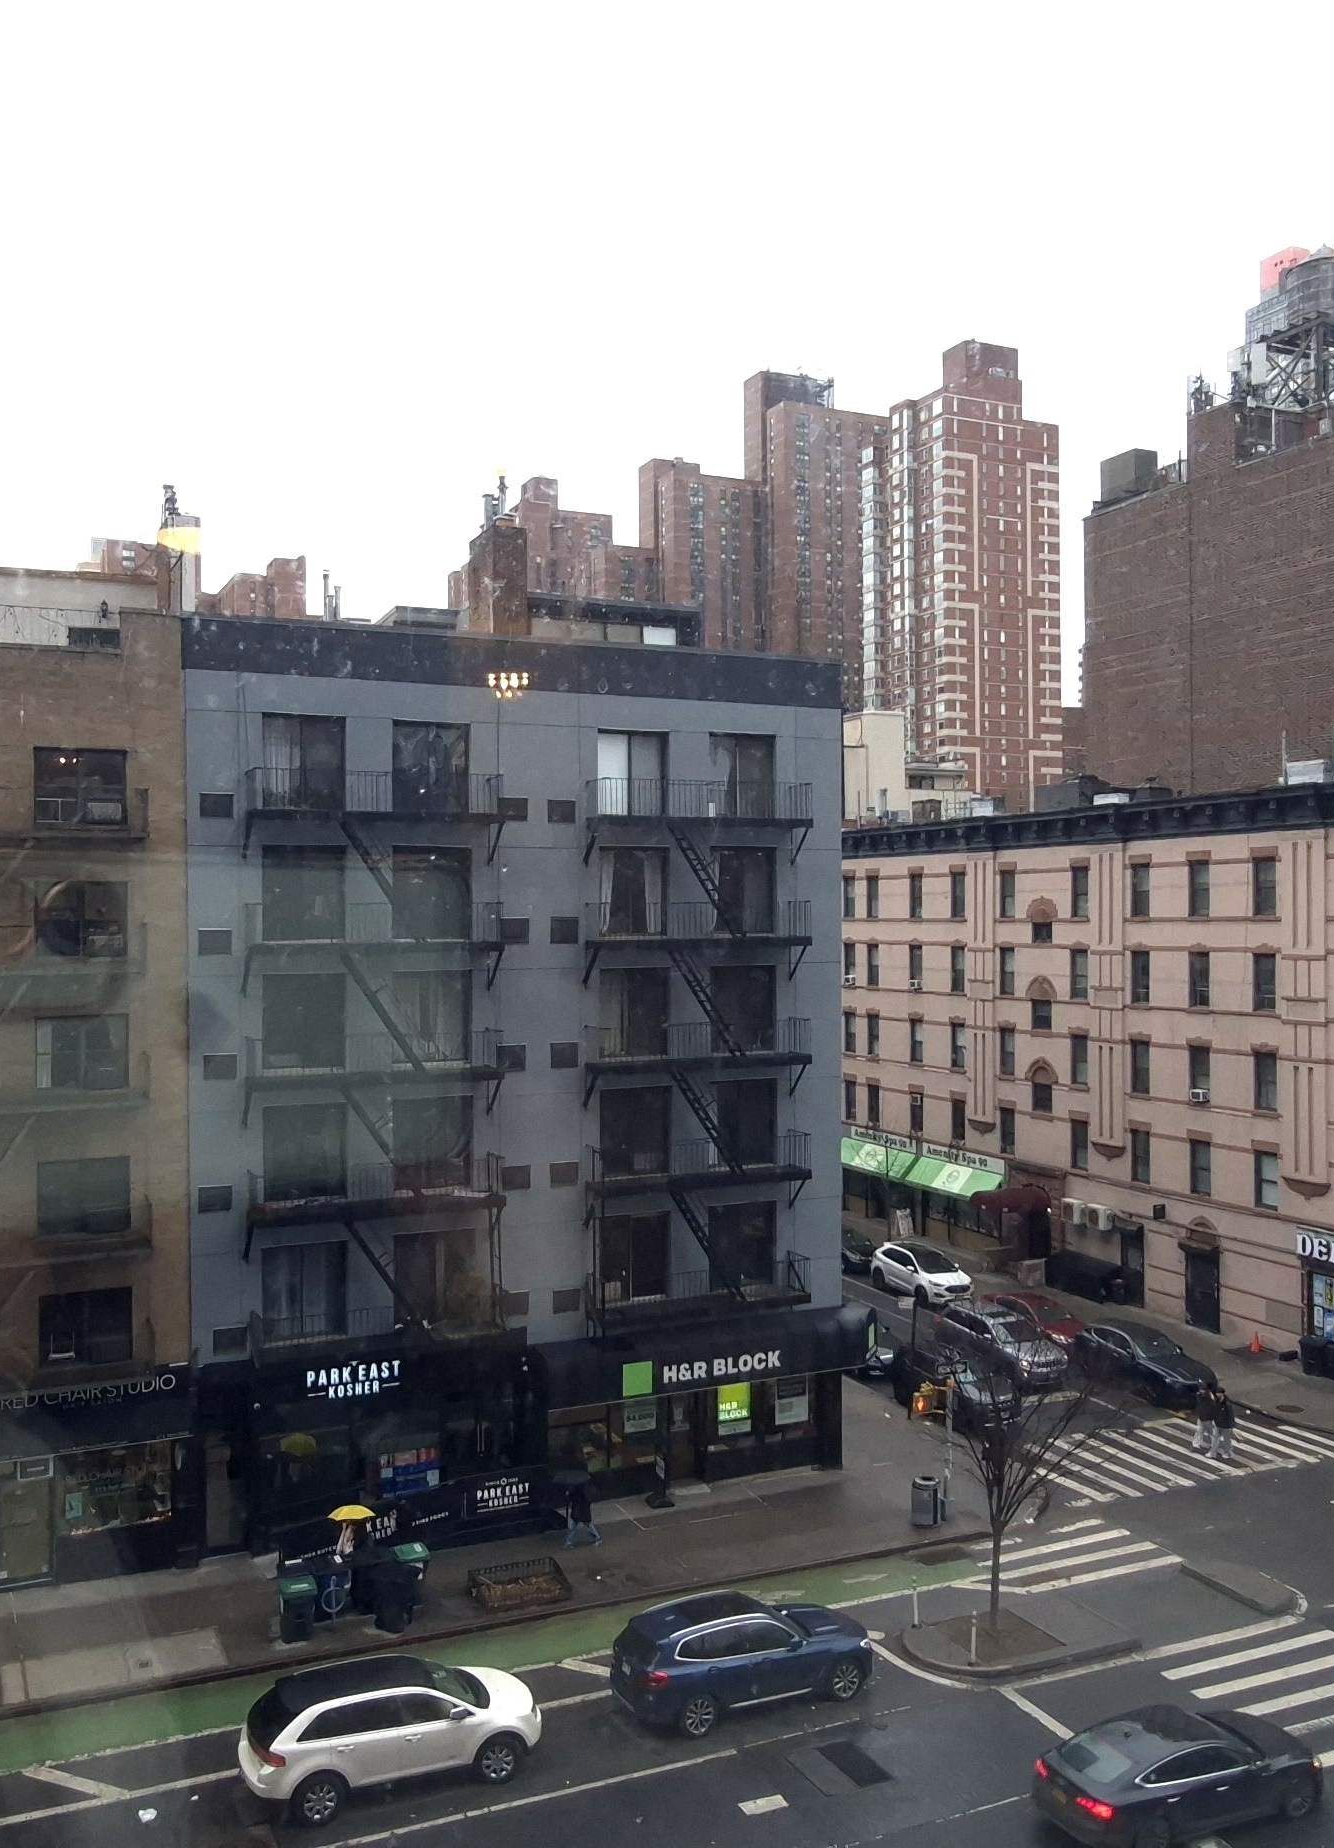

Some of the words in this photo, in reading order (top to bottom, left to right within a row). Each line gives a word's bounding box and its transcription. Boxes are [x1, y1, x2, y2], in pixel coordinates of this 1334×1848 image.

[925, 1144, 960, 1162] Amenity
[961, 1152, 978, 1167] Spa
[307, 1365, 352, 1388] PARK
[358, 1360, 401, 1381] EAST
[663, 1361, 708, 1384] H&R
[713, 1350, 782, 1377] BLOCK
[43, 1385, 102, 1406] CHAIR
[105, 1374, 176, 1397] STUDIO
[328, 1380, 380, 1399] KOSHER
[719, 1401, 738, 1411] H&R
[719, 1407, 748, 1419] BLOCK
[476, 1486, 503, 1500] PARK
[505, 1482, 530, 1496] EAST
[488, 1495, 519, 1507] KOSHER
